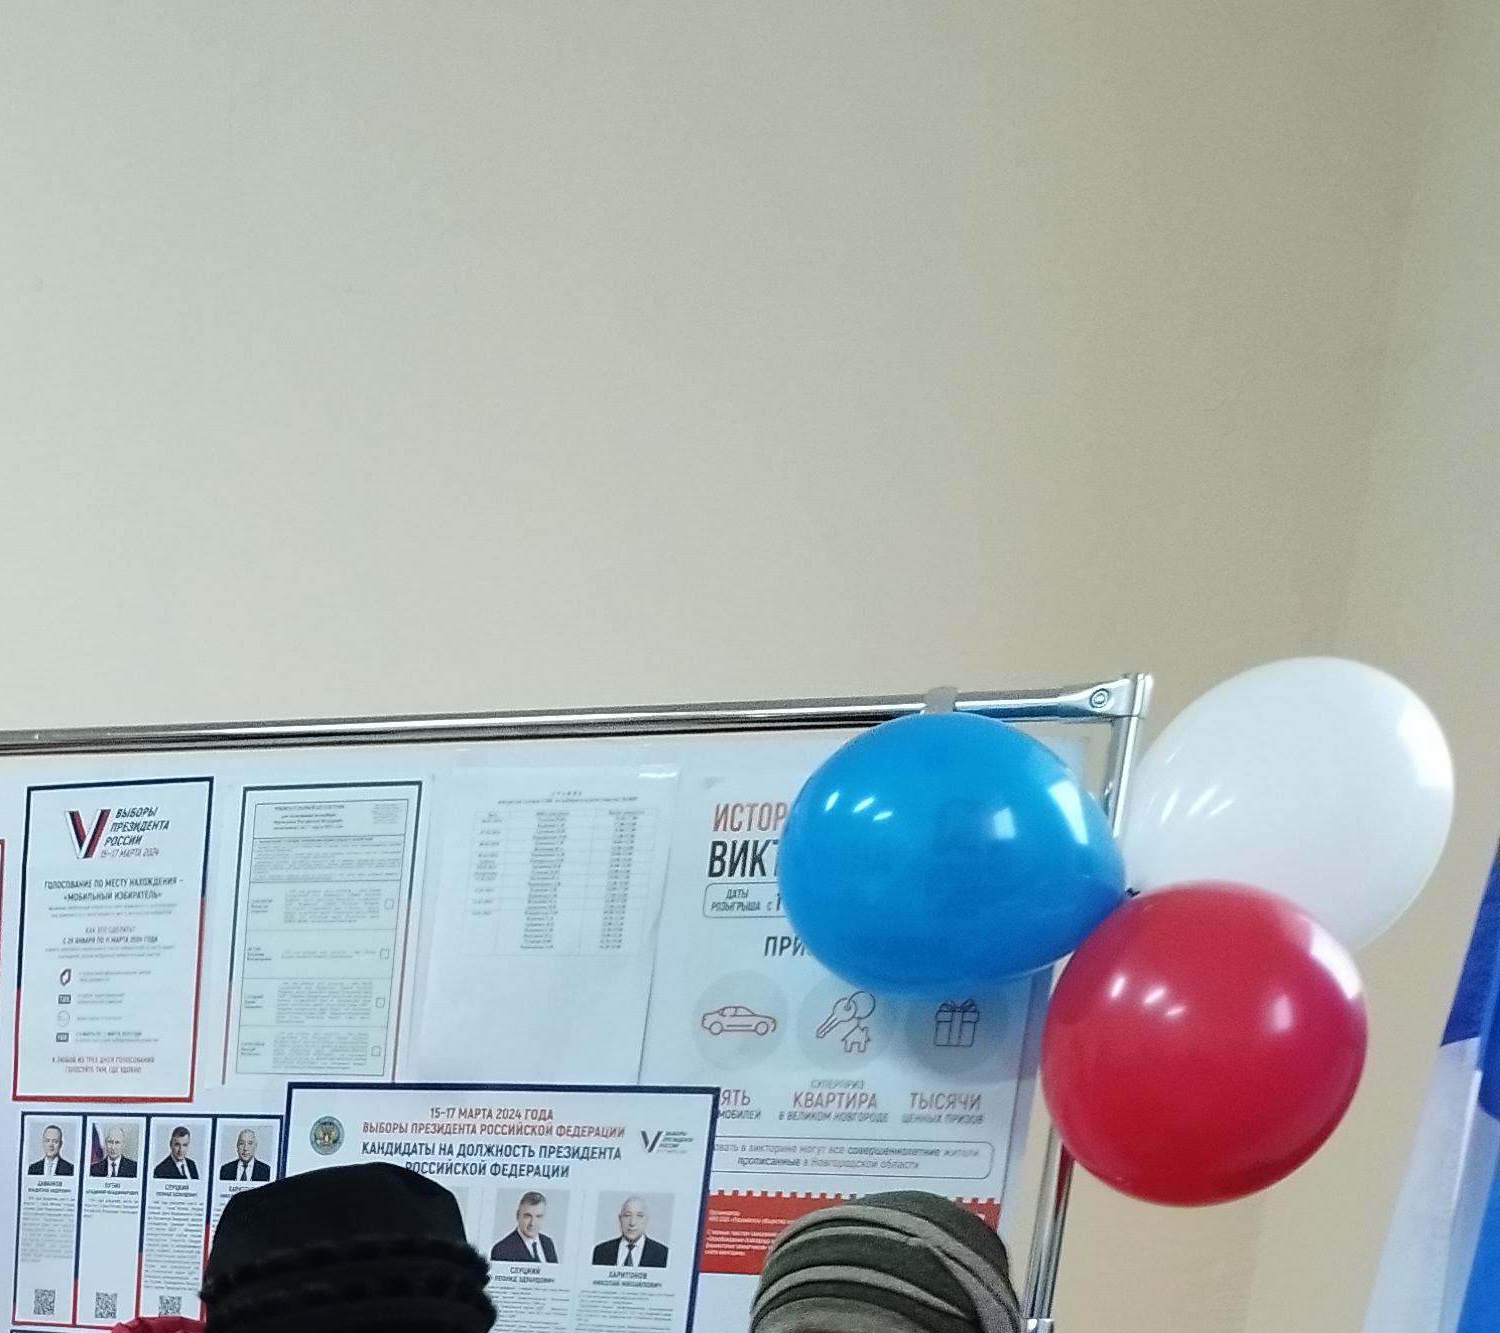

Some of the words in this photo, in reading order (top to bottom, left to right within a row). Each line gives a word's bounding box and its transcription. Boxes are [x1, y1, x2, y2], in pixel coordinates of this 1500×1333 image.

[115, 806, 159, 819] ВЫБОРЫ
[713, 802, 788, 832] ИСТОР
[110, 820, 170, 833] ПРЕЗИДЕНТА
[104, 835, 144, 847] РОССИИ
[105, 878, 128, 888] МЕСТУ
[726, 889, 749, 900] ДАТЫ
[711, 901, 761, 912] РОЗЫГРЫША
[721, 1089, 751, 1106] ЯТЬ
[793, 1091, 877, 1109] КВАРТИРА
[910, 1092, 982, 1110] ТЫСЯЧИ
[458, 1107, 493, 1120] МАРТА
[496, 1108, 521, 1120] 2024
[524, 1109, 554, 1121] ГОДА
[719, 1109, 761, 1120] МОБИЛЕЙ
[362, 1122, 408, 1134] ВЫБОРЫ
[410, 1122, 477, 1136] ПРЕЗИДЕНТА
[480, 1122, 553, 1137] РОССИЙСКОЙ
[555, 1124, 625, 1139] ФЕДЕРАЦИИ
[362, 1141, 435, 1157] КАНДИДАТЫ
[438, 1143, 454, 1156] НА
[456, 1143, 535, 1158] ДОЛЖНОСТЬ
[539, 1145, 622, 1161] ПРЕЗИДЕНТА
[405, 1159, 487, 1176] РОССИЙСКОЙ
[490, 1162, 570, 1179] ФЕДЕРАЦИИ
